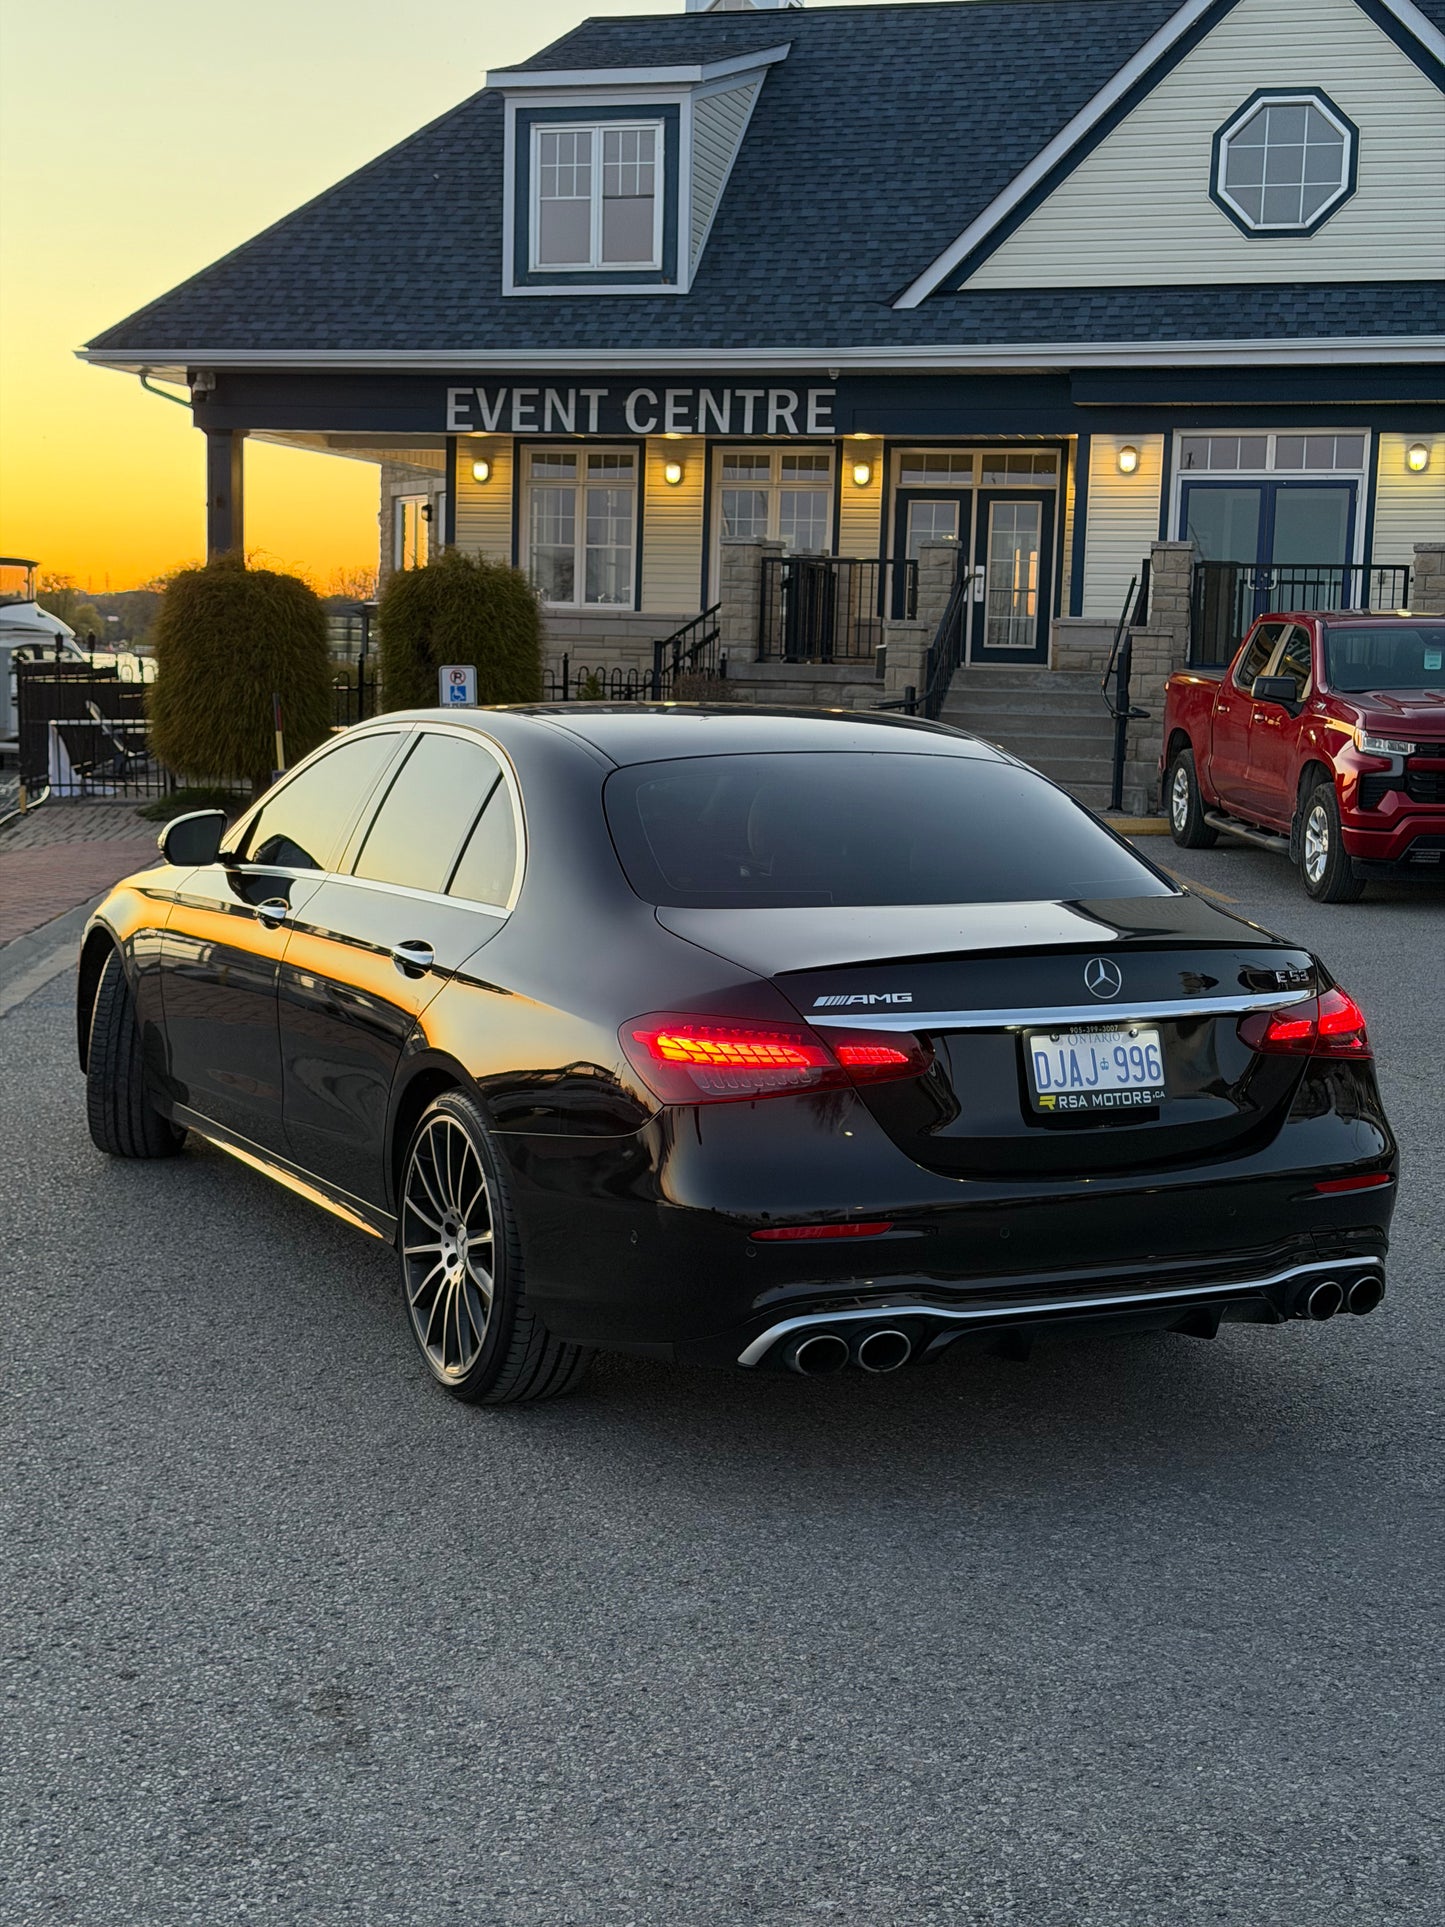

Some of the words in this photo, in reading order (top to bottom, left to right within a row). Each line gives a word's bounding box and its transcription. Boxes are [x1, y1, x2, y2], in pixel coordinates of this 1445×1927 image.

[446, 388, 608, 432] EVENT
[625, 388, 837, 434] CENTRE
[1275, 971, 1288, 983] E
[1289, 970, 1310, 982] 53
[1069, 1024, 1119, 1034] 905-399-3007
[1067, 1032, 1121, 1046] ONTARIO
[1034, 1048, 1099, 1089] DJAJ
[1113, 1044, 1161, 1083] 996
[1059, 1095, 1088, 1109] RSA
